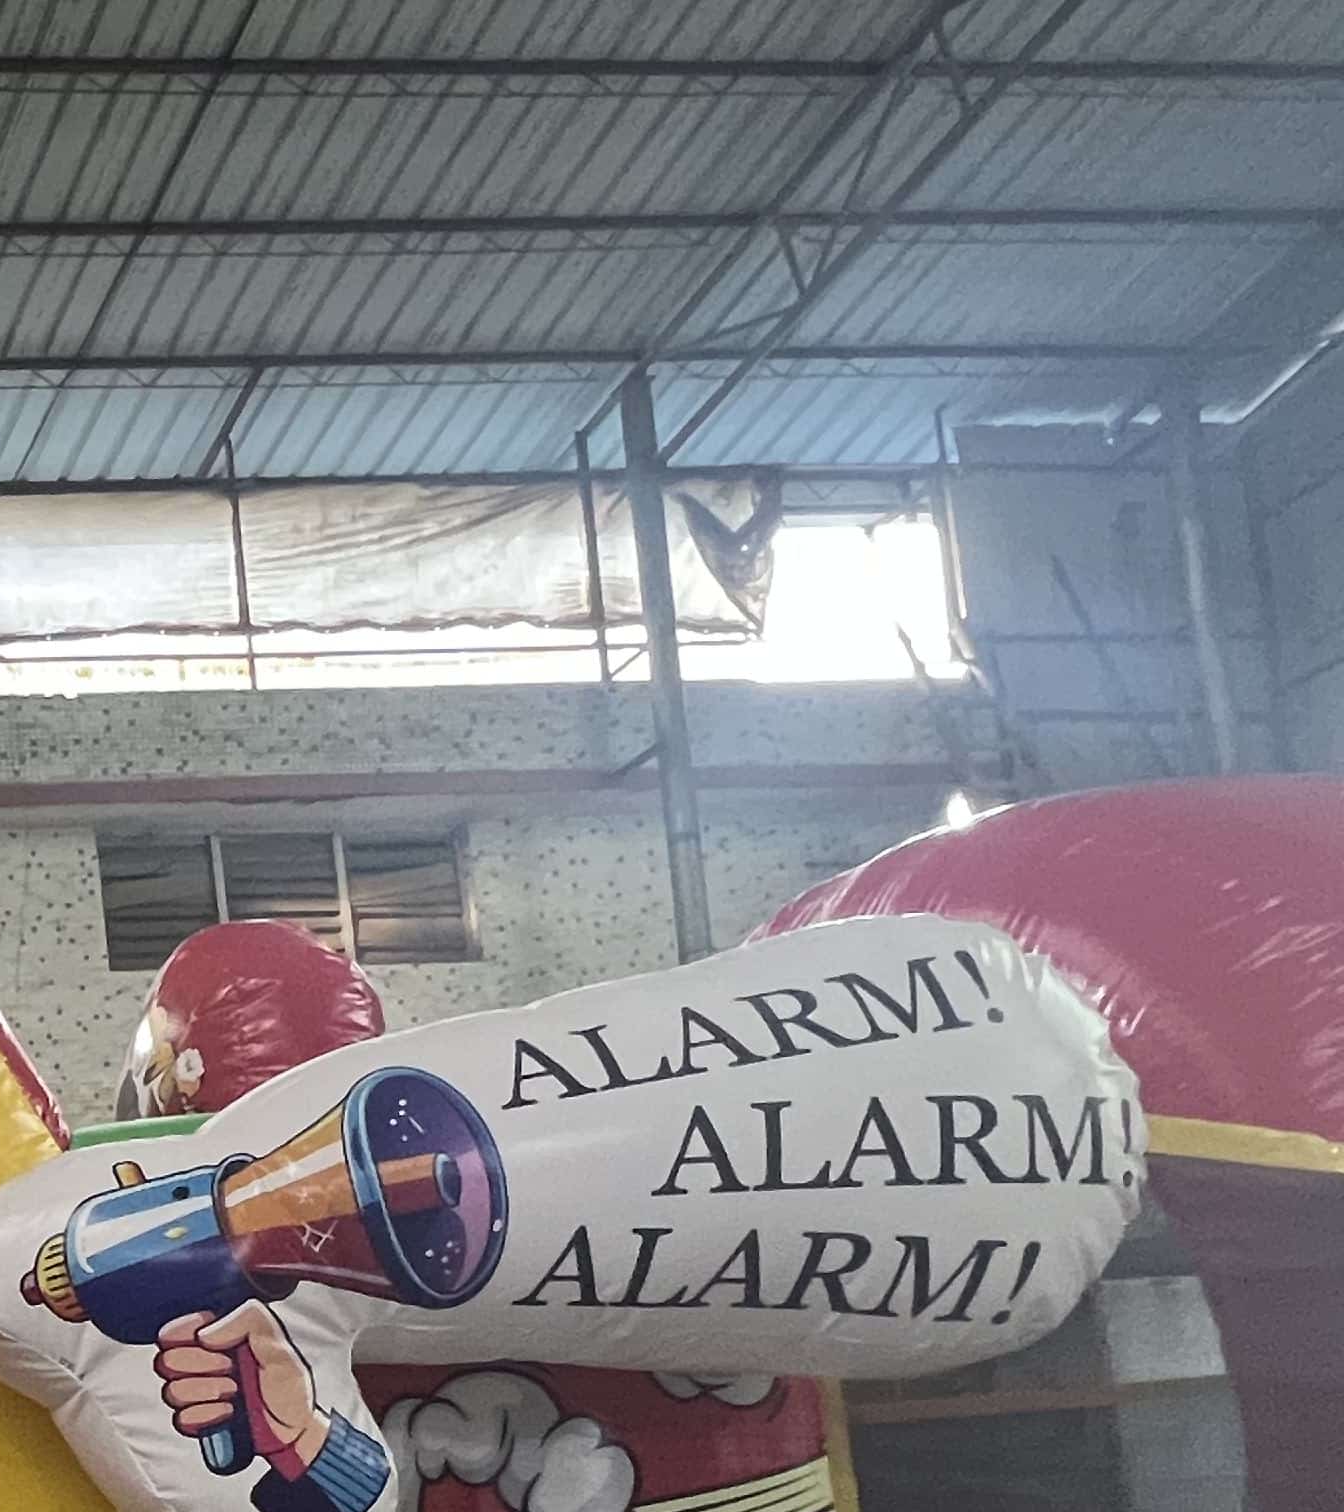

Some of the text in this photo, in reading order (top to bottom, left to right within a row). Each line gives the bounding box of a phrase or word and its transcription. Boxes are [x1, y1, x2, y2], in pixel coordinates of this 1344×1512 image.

[500, 949, 1004, 1111] ALARM!
[651, 1094, 1136, 1196] ALARM!
[513, 1224, 1042, 1326] ALARM!
